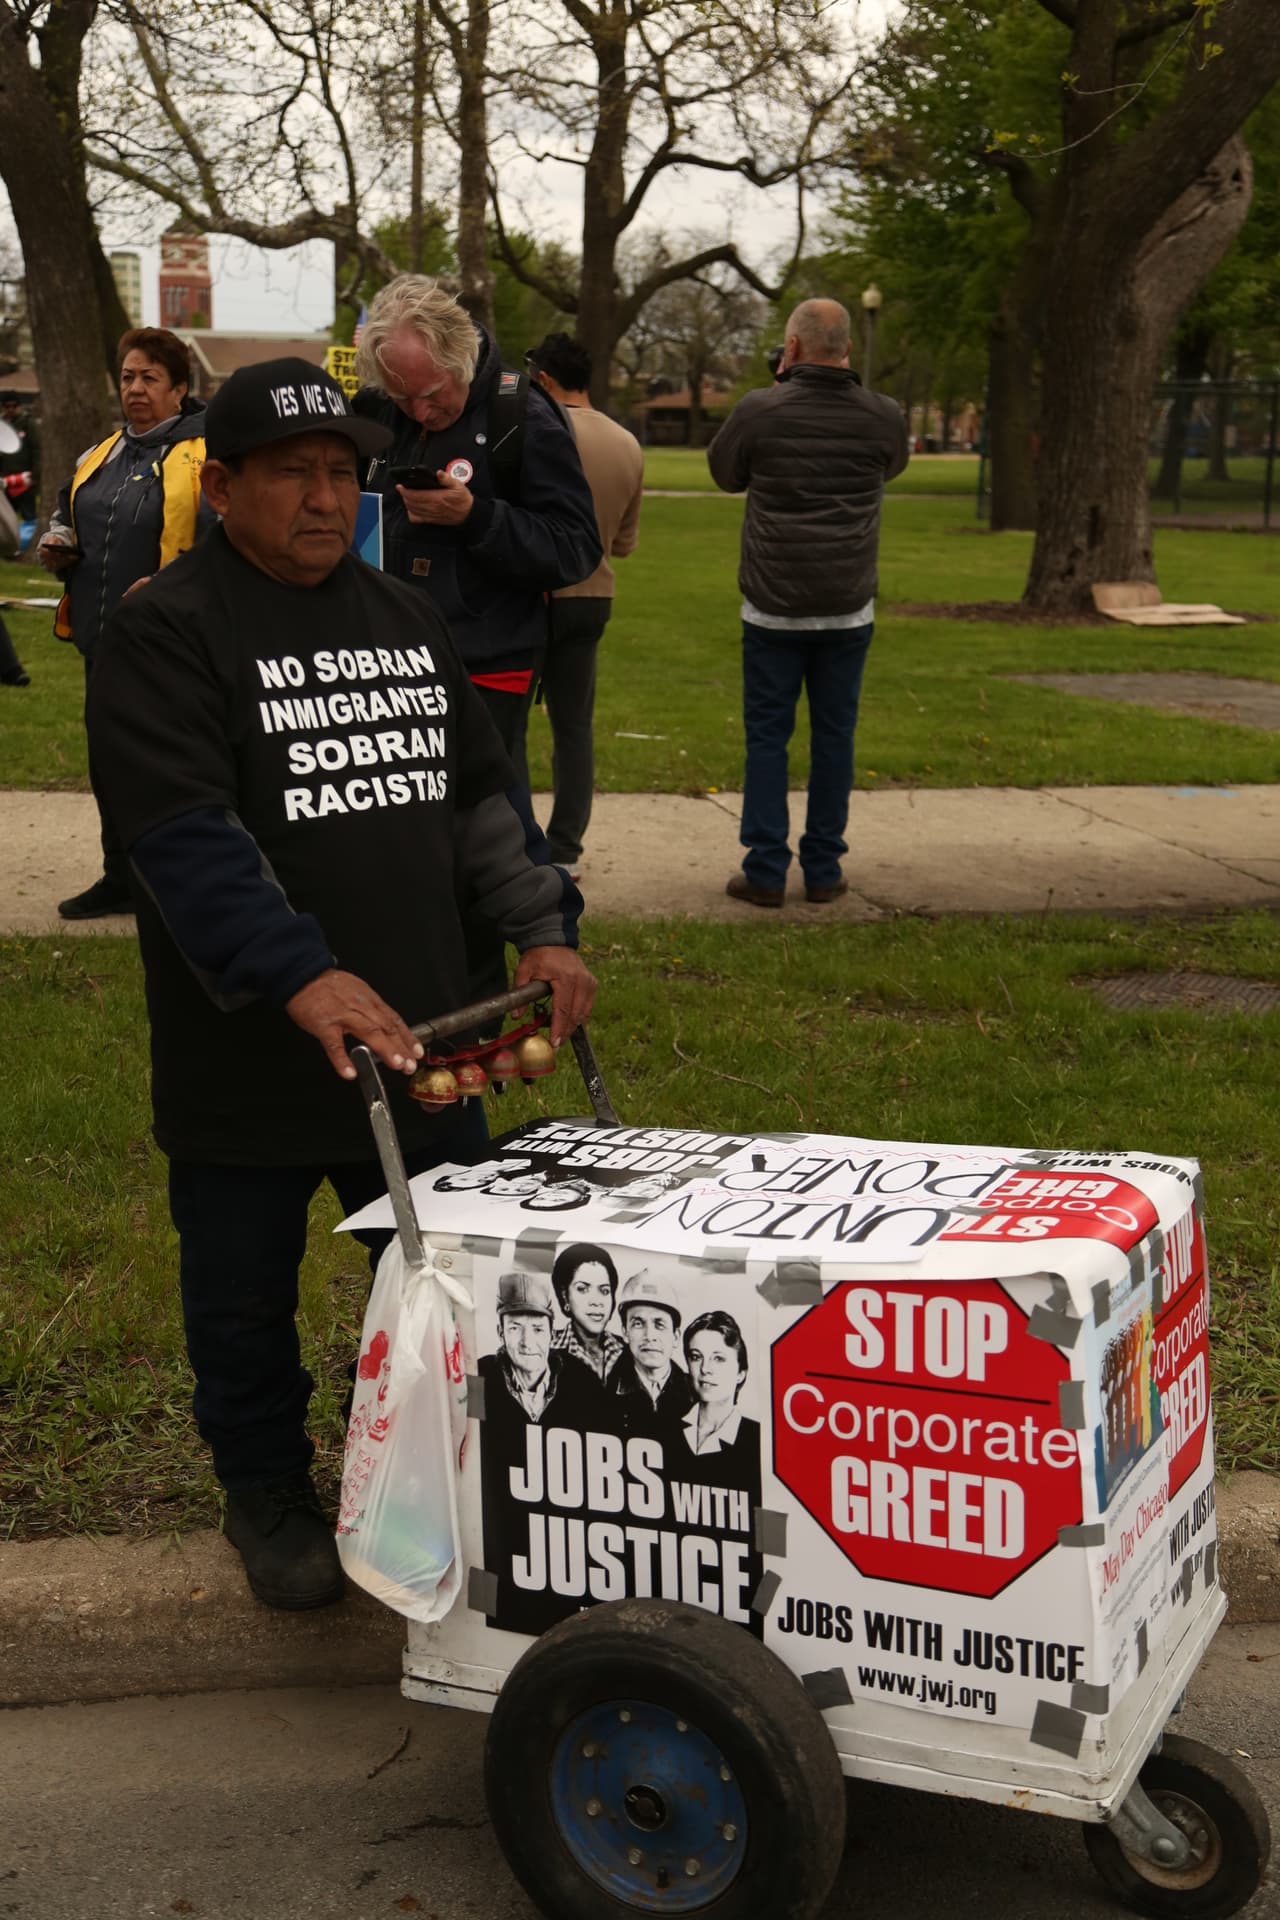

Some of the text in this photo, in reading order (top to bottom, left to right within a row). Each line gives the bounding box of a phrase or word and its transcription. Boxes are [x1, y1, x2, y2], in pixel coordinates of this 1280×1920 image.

[270, 384, 346, 419] YES WE CAN
[256, 645, 436, 689] NO SOBRAN
[259, 685, 448, 734] INMIGRANTES
[288, 727, 446, 775] SOBRAN
[284, 770, 447, 821] RACISTAS
[500, 1139, 721, 1173] JOBS WITH
[523, 1122, 753, 1152] JUSTICE
[719, 1153, 1010, 1198] POWER
[1121, 1159, 1192, 1187] JOBS
[636, 1194, 952, 1246] UNION
[1162, 1207, 1194, 1303] STOP
[845, 1287, 1008, 1382] STOP
[782, 1383, 1078, 1469] Corporate
[1160, 1352, 1206, 1458] GREED
[509, 1424, 750, 1532] JOBS WITH
[831, 1455, 1025, 1560] GREED
[1169, 1509, 1189, 1567] WITH
[1191, 1480, 1216, 1536] JUSTI
[1103, 1553, 1121, 1593] May
[1120, 1525, 1135, 1566] Day
[1136, 1483, 1168, 1539] Chicago
[512, 1513, 750, 1625] JUSTICE
[778, 1597, 853, 1643] JOBS
[863, 1610, 943, 1662] WITH
[953, 1628, 1085, 1684] JUSTICE
[858, 1666, 997, 1715] www.jwj.org
